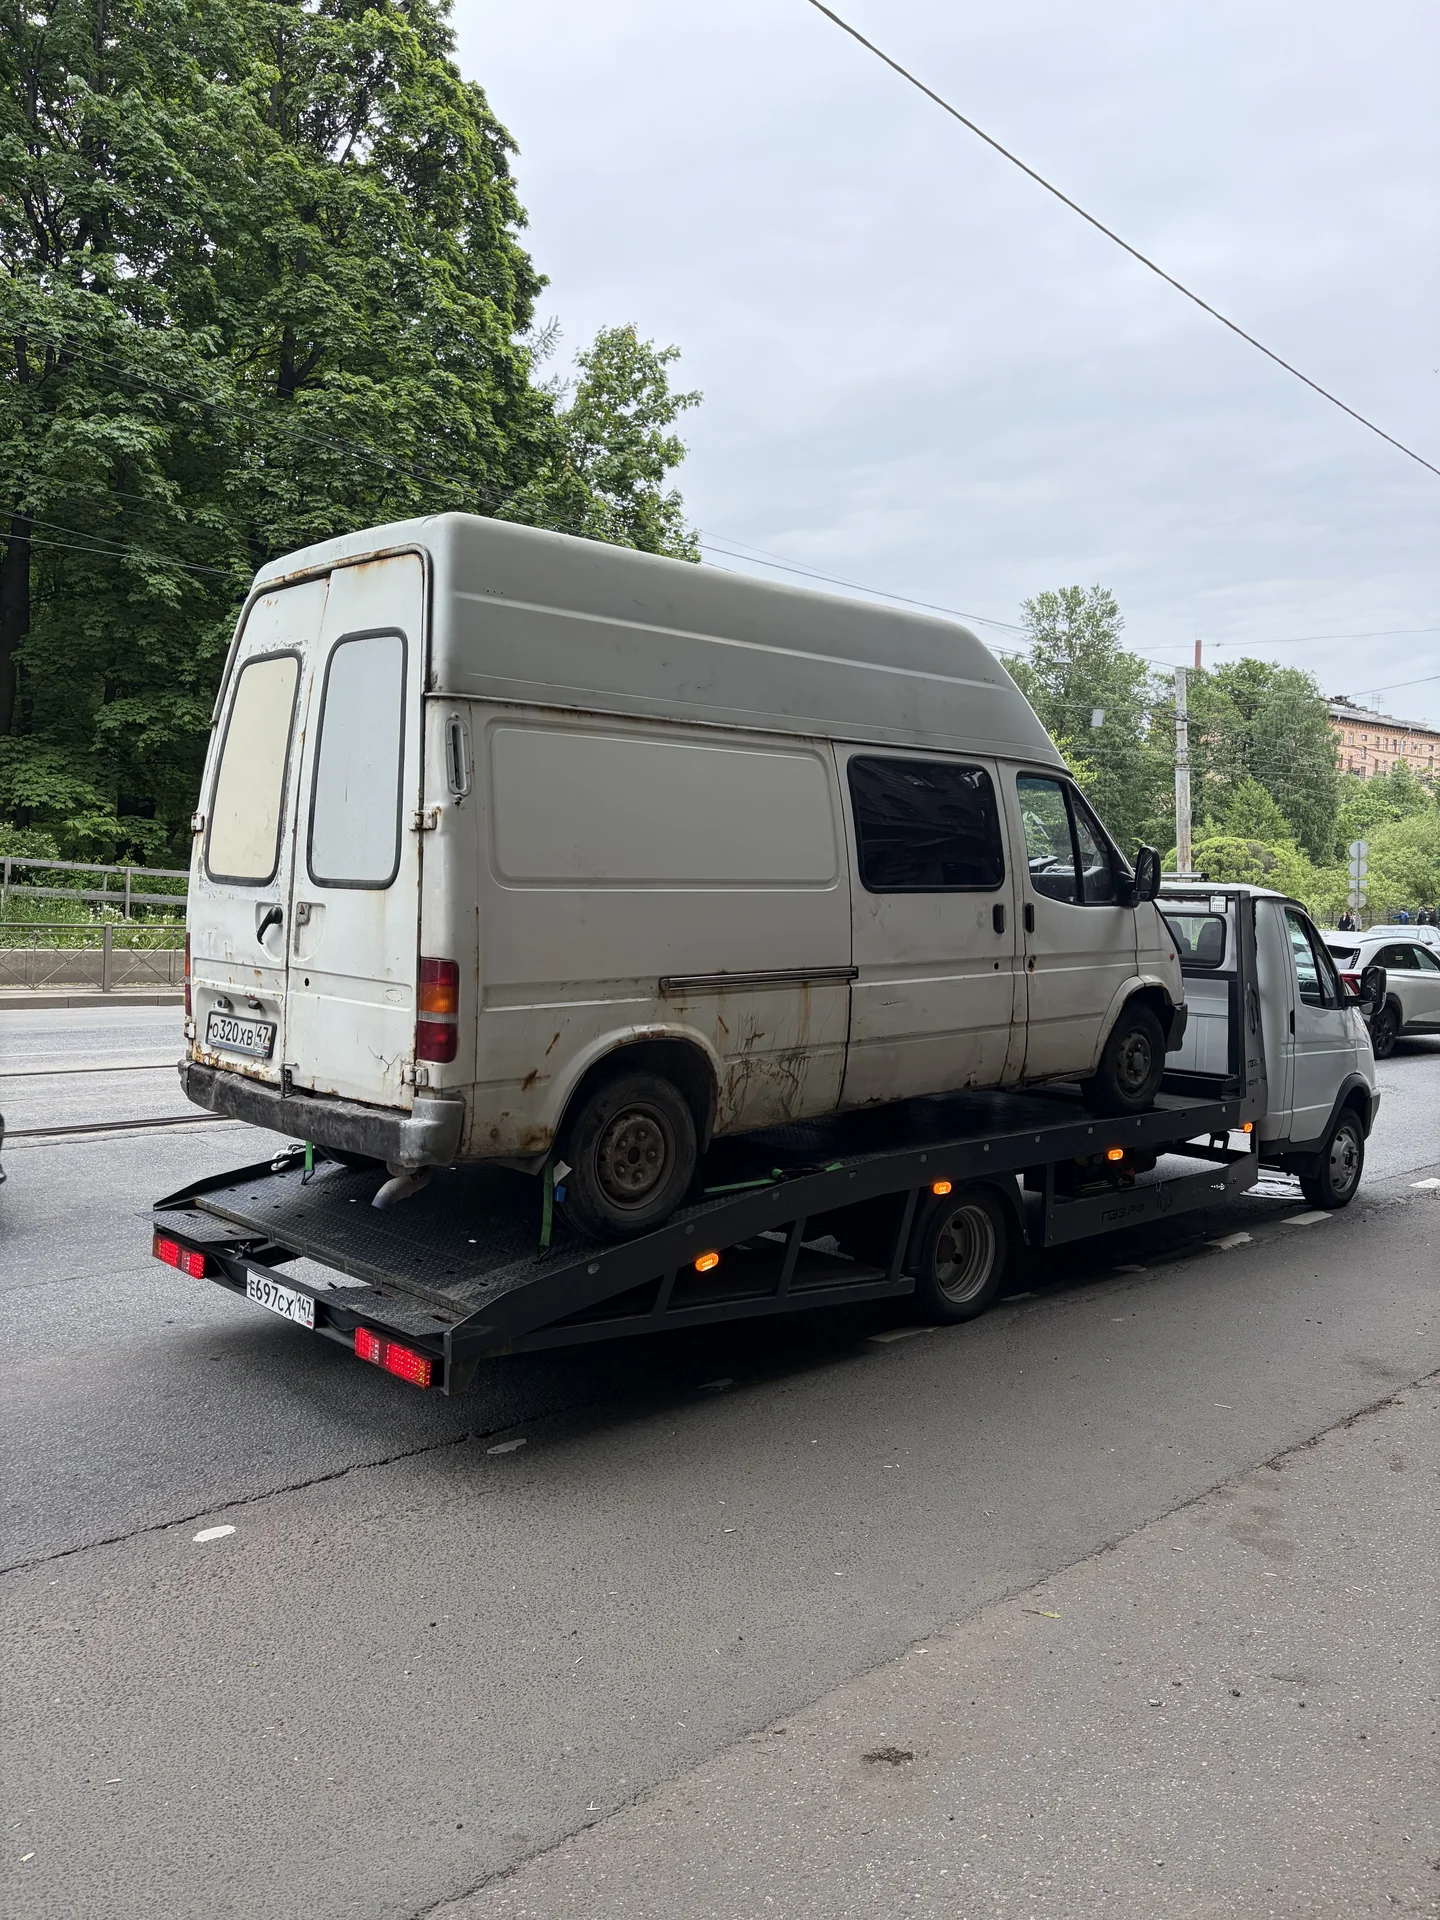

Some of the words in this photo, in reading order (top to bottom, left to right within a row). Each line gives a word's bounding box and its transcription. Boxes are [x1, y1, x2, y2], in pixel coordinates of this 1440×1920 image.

[212, 1019, 254, 1046] О320ХВ
[256, 1026, 269, 1043] 47
[249, 1280, 295, 1317] Е697СХ
[297, 1296, 312, 1319] 147
